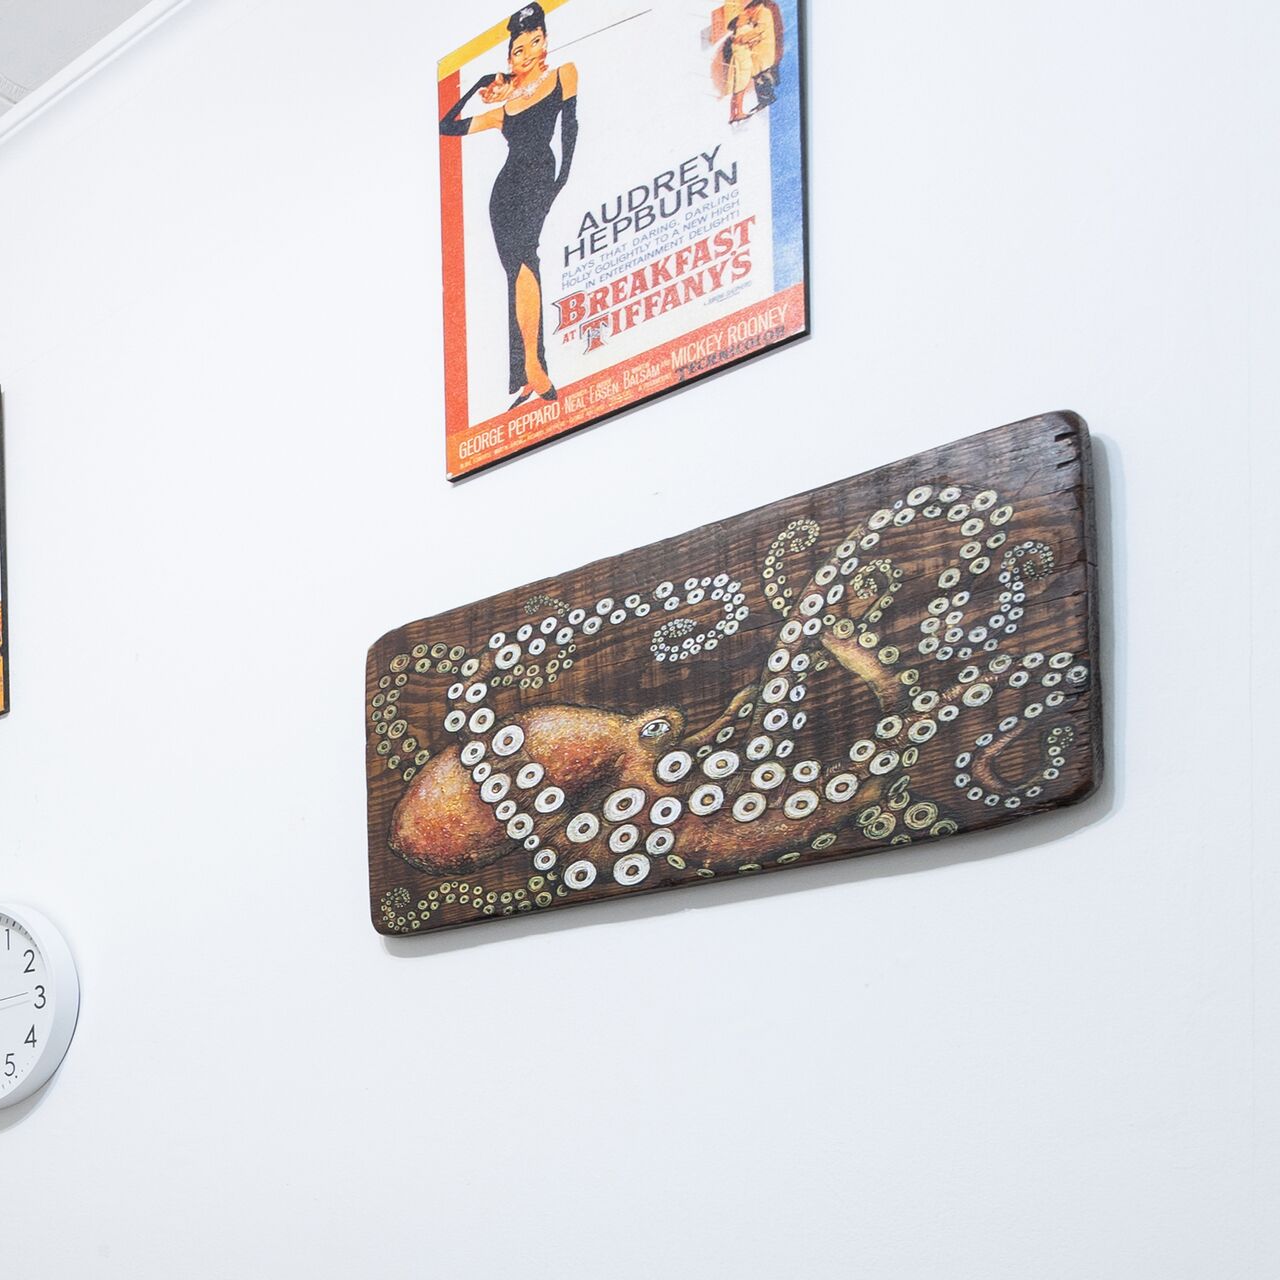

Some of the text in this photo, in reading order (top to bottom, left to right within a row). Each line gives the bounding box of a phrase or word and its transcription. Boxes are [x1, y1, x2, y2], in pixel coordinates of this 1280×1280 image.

[562, 260, 595, 279] PLAYS
[600, 243, 628, 262] THAT
[685, 189, 740, 220] DARLING
[564, 161, 738, 267] HEPBURN
[578, 144, 722, 238] AUDREY
[552, 215, 756, 335] BREAKFAST
[561, 200, 740, 290] HOLLY GOLIGHTLY TO A NEW HIGH
[585, 210, 740, 289] IN ENTERTAINMENT DELIGHT!
[562, 331, 577, 344] AT
[580, 250, 752, 355] TIFFANY'S
[459, 425, 505, 459] GEORGE
[508, 401, 560, 438] PEPPARD
[564, 395, 586, 414] NEAL
[589, 384, 619, 404] EBSEN
[623, 364, 661, 390] BALSAM
[671, 332, 723, 369] MICKEY
[727, 304, 788, 344] ROONEY
[5, 928, 11, 951] 1
[23, 949, 36, 974] 2
[24, 1024, 37, 1048] 4
[34, 985, 46, 1009] 3
[4, 1053, 16, 1077] 5
